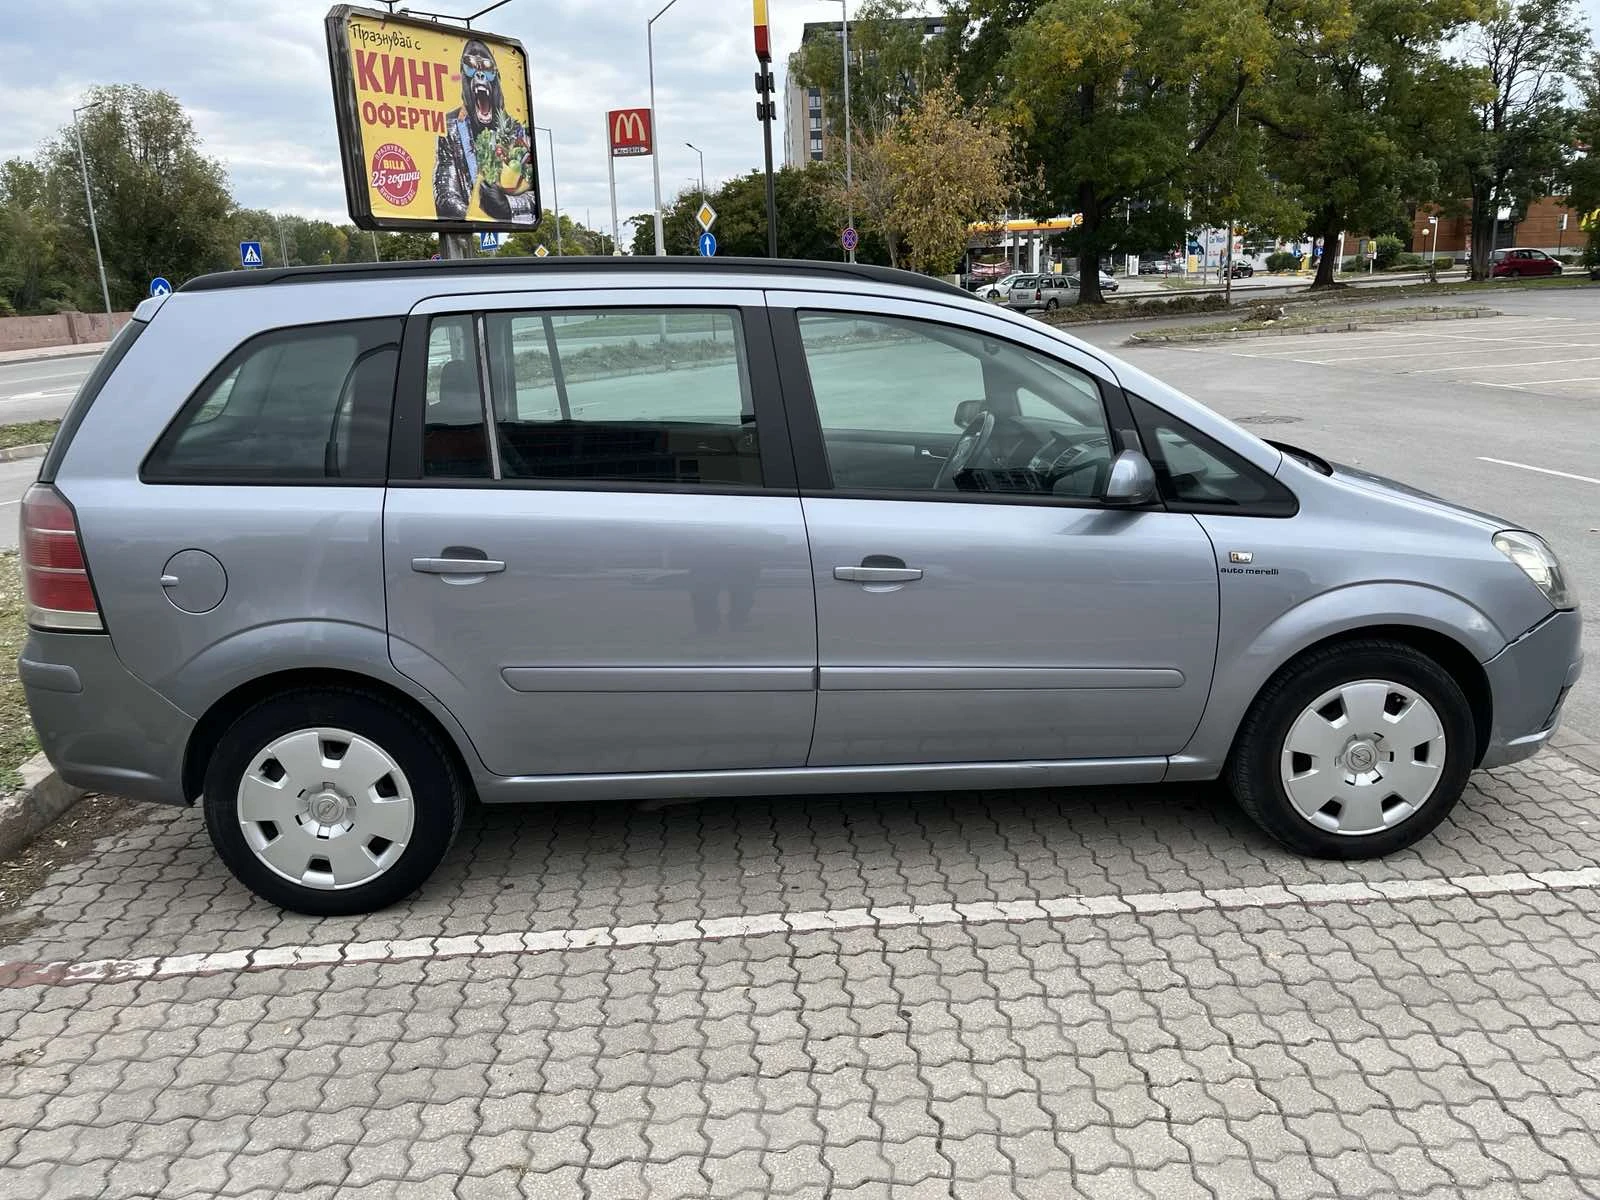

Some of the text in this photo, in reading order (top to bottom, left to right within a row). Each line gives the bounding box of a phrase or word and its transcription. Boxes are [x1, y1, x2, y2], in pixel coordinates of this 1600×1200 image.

[350, 24, 421, 52] Празнувай с
[355, 49, 448, 102] КИНГ
[363, 101, 445, 133] ОФЕРТИ
[372, 170, 386, 187] 25
[383, 160, 406, 170] BILLA
